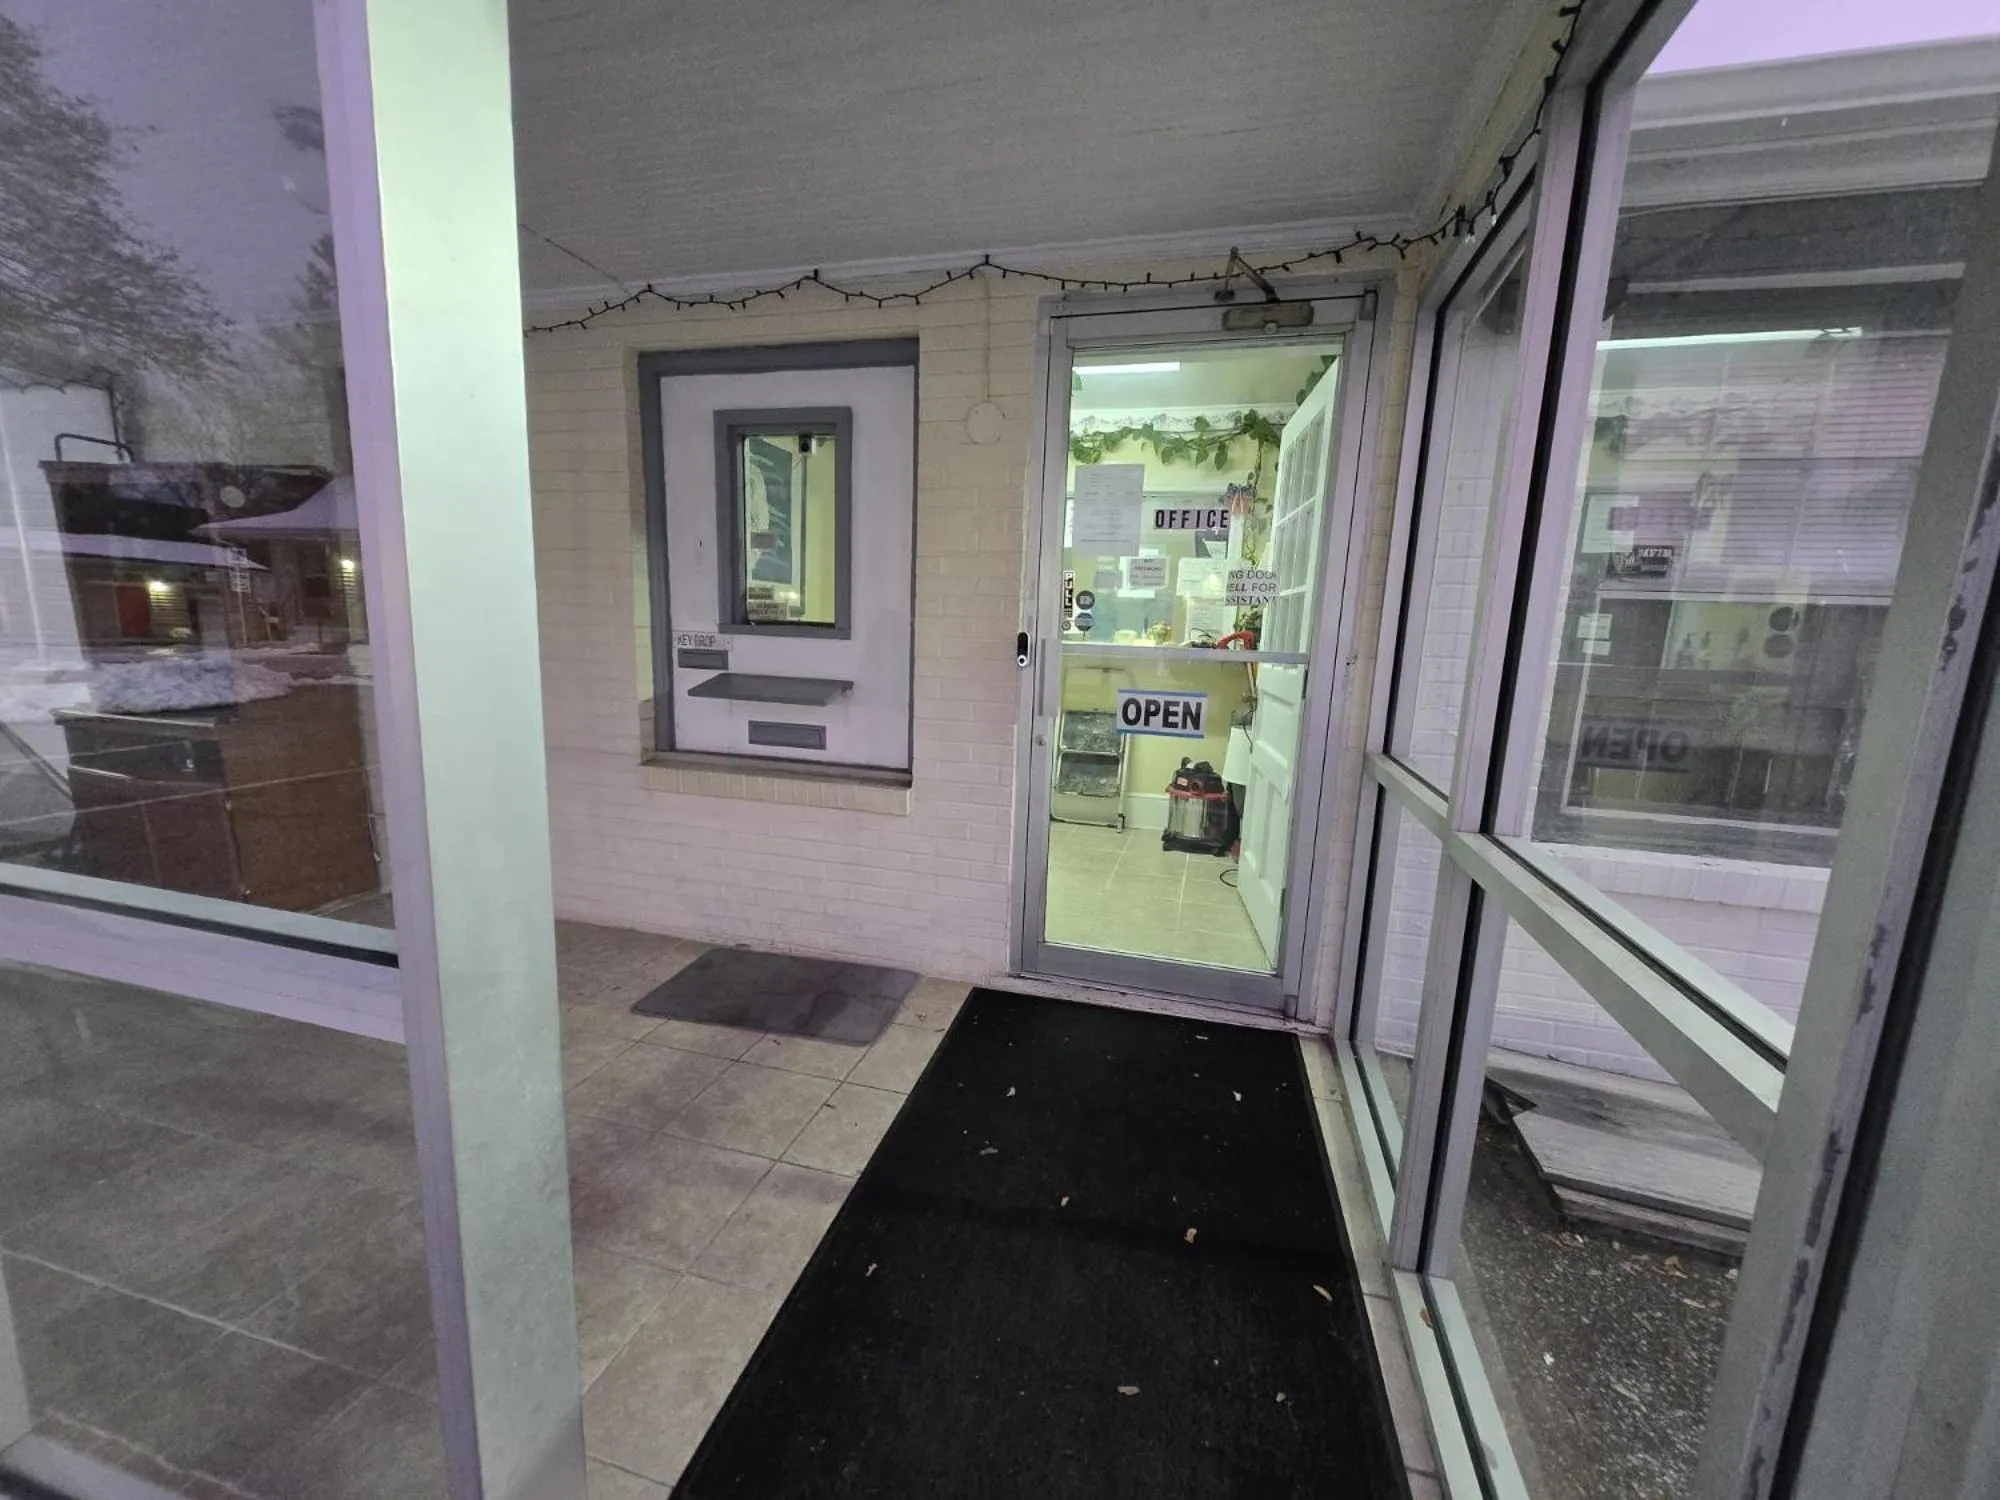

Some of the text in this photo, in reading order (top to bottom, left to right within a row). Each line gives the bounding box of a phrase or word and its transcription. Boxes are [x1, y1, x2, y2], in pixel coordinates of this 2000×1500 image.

[1155, 509, 1229, 528] OFFICE
[1251, 583, 1277, 592] FOR
[677, 634, 692, 646] KEY
[1121, 697, 1202, 731] OPEN
